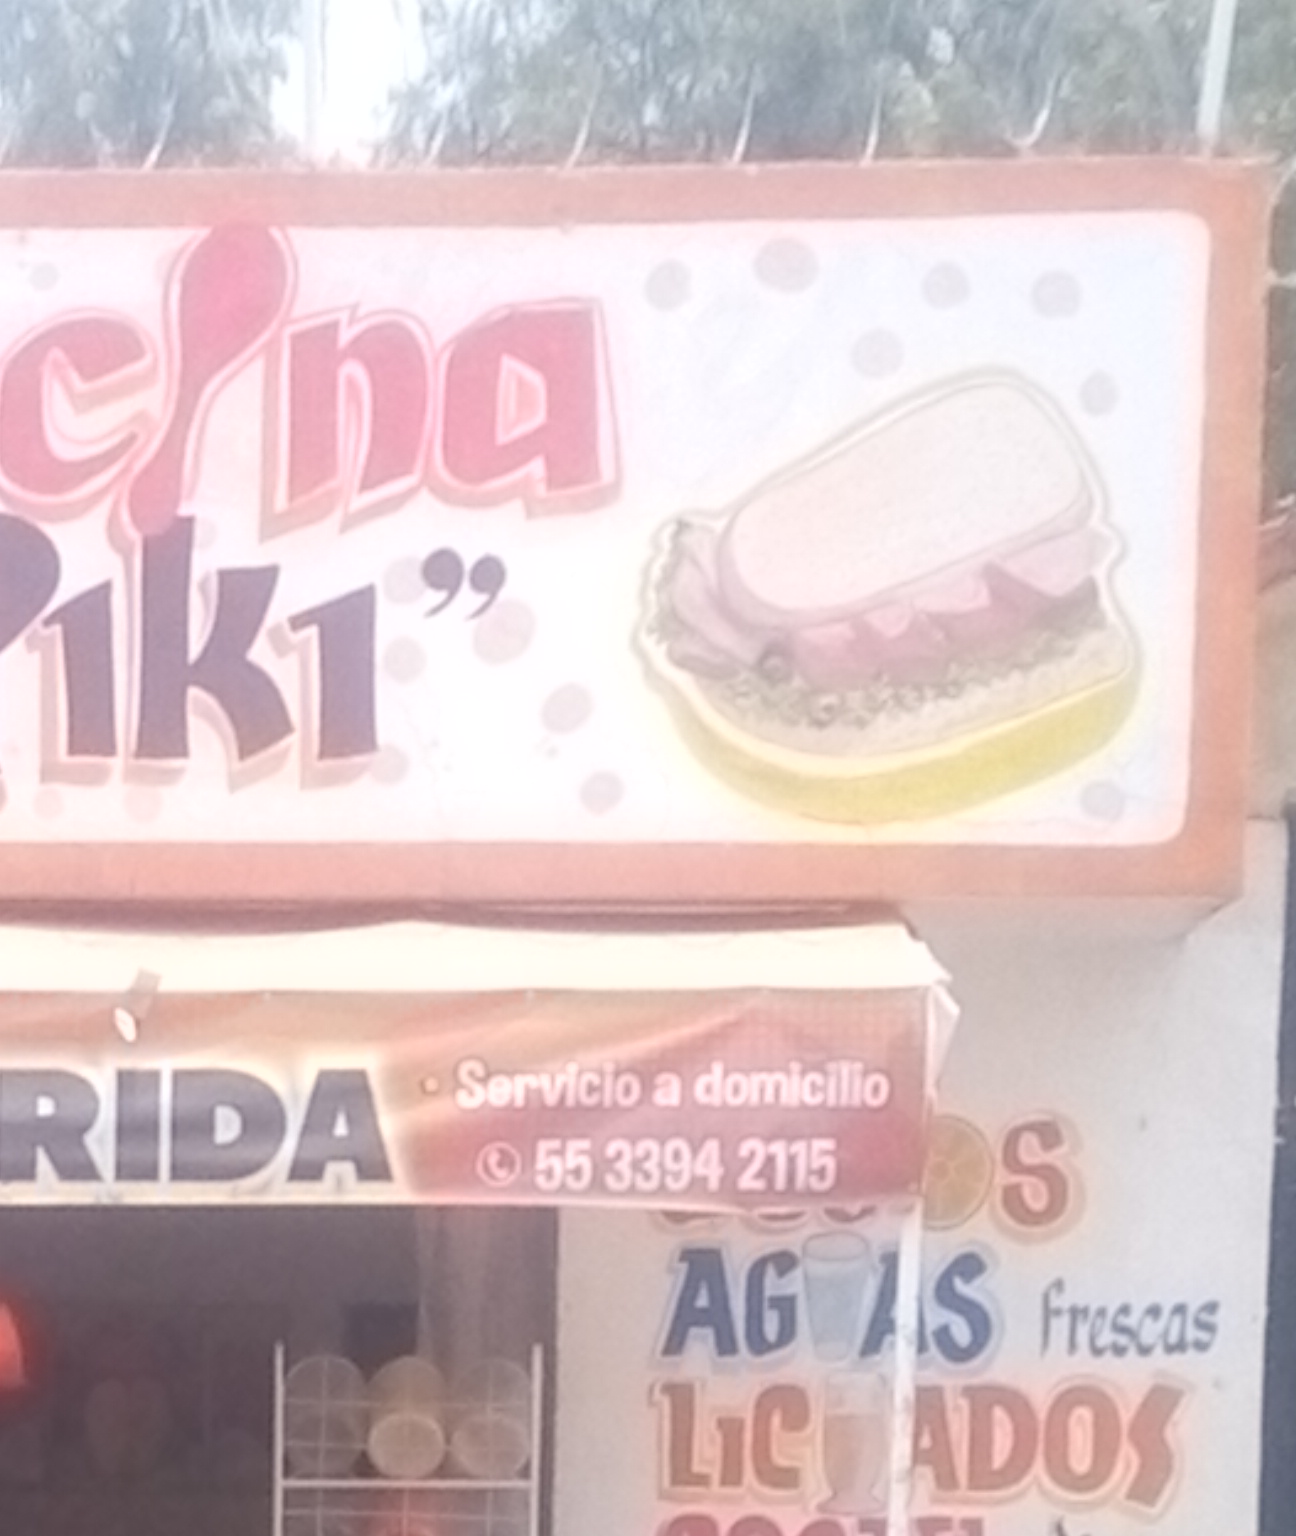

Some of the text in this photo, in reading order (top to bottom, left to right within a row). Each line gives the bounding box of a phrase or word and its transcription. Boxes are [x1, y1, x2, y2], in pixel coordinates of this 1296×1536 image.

[454, 1060, 890, 1109] Servicio a domicilio
[533, 1138, 837, 1191] 55 3394 2115
[1040, 1277, 1220, 1359] frescas
